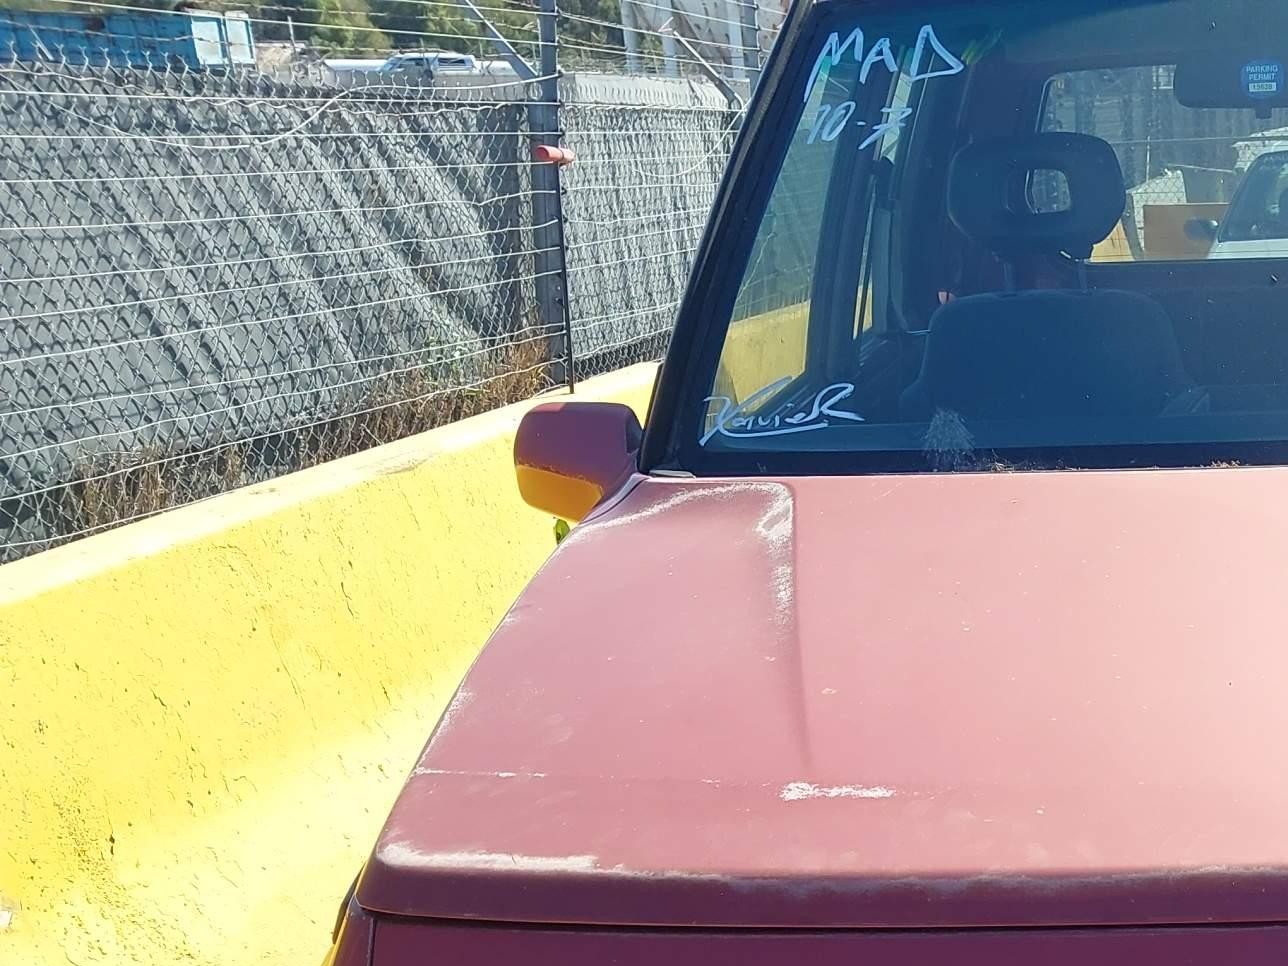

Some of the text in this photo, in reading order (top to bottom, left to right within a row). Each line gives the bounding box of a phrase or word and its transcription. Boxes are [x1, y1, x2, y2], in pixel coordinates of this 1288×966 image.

[804, 24, 965, 102] MAD
[1246, 64, 1279, 73] PARKING
[1248, 73, 1276, 81] PERMIT
